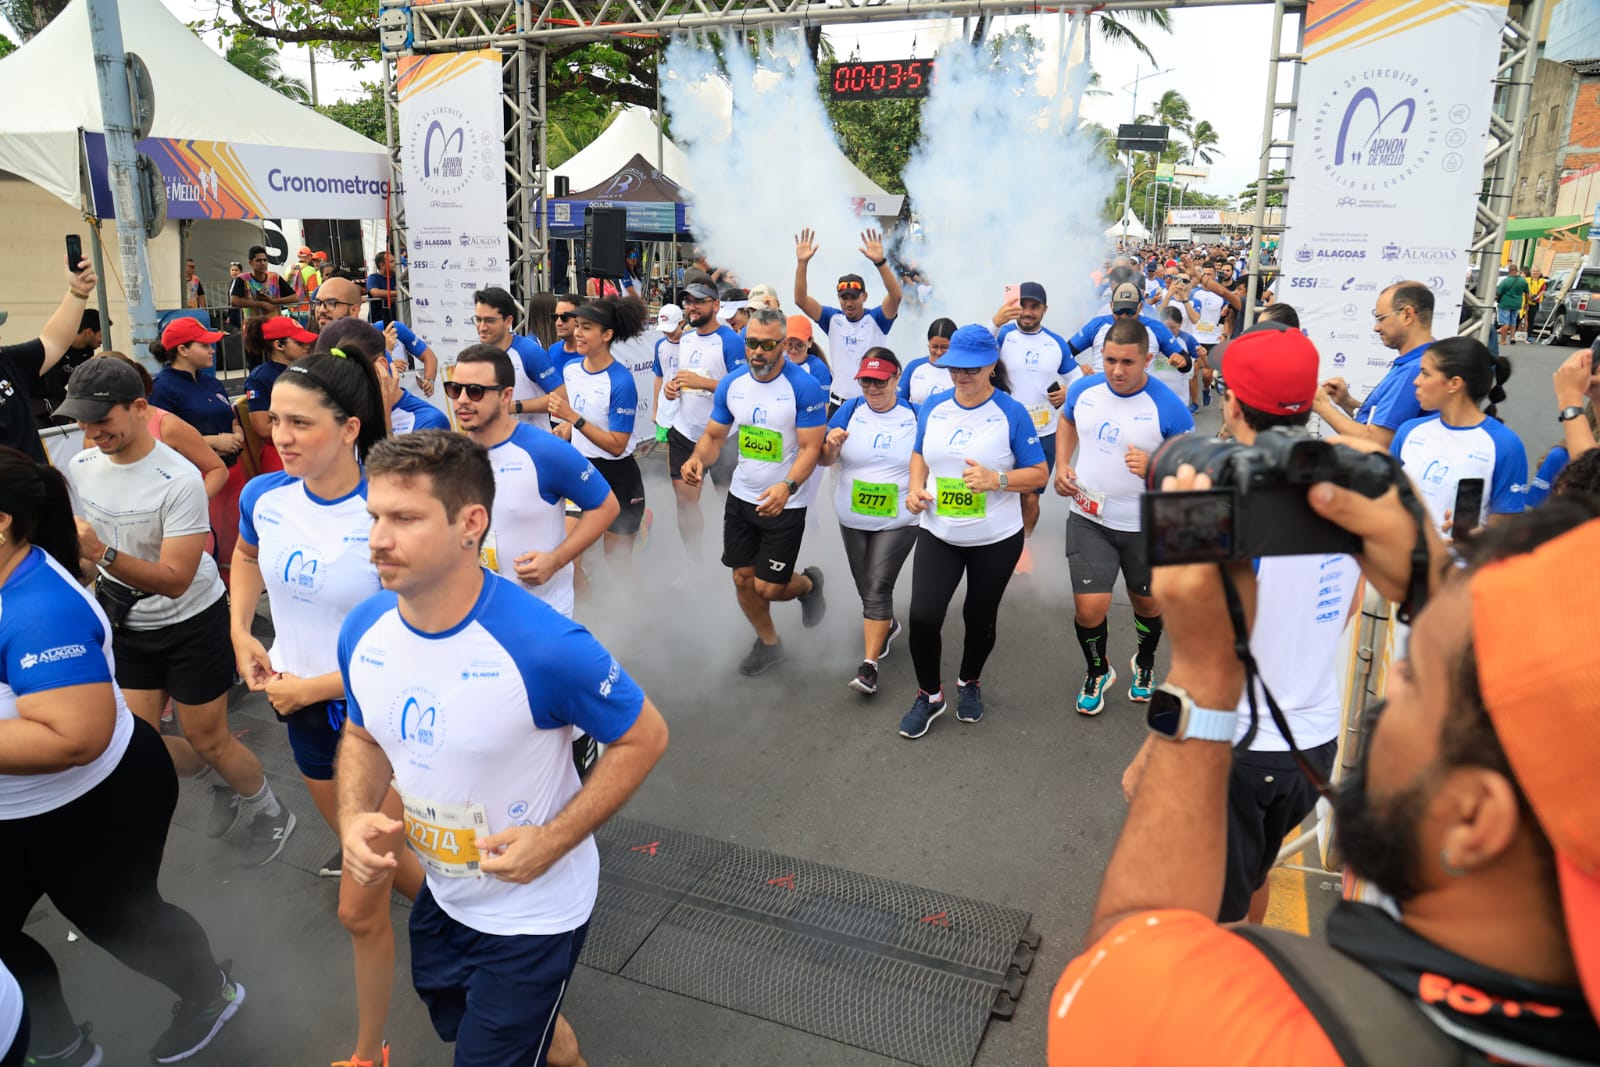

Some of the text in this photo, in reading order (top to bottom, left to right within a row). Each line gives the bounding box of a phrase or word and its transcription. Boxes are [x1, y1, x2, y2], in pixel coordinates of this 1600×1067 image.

[1363, 68, 1419, 87] CIRCUITO
[1369, 138, 1407, 154] ARNON
[1379, 153, 1405, 166] MELLO
[171, 182, 200, 201] MELLO
[1317, 249, 1367, 259] ALAGOAS
[1402, 248, 1457, 260] ALAGOAS
[858, 493, 887, 506] 2777
[941, 491, 973, 506] 2768
[39, 644, 87, 662] ALAGOAS
